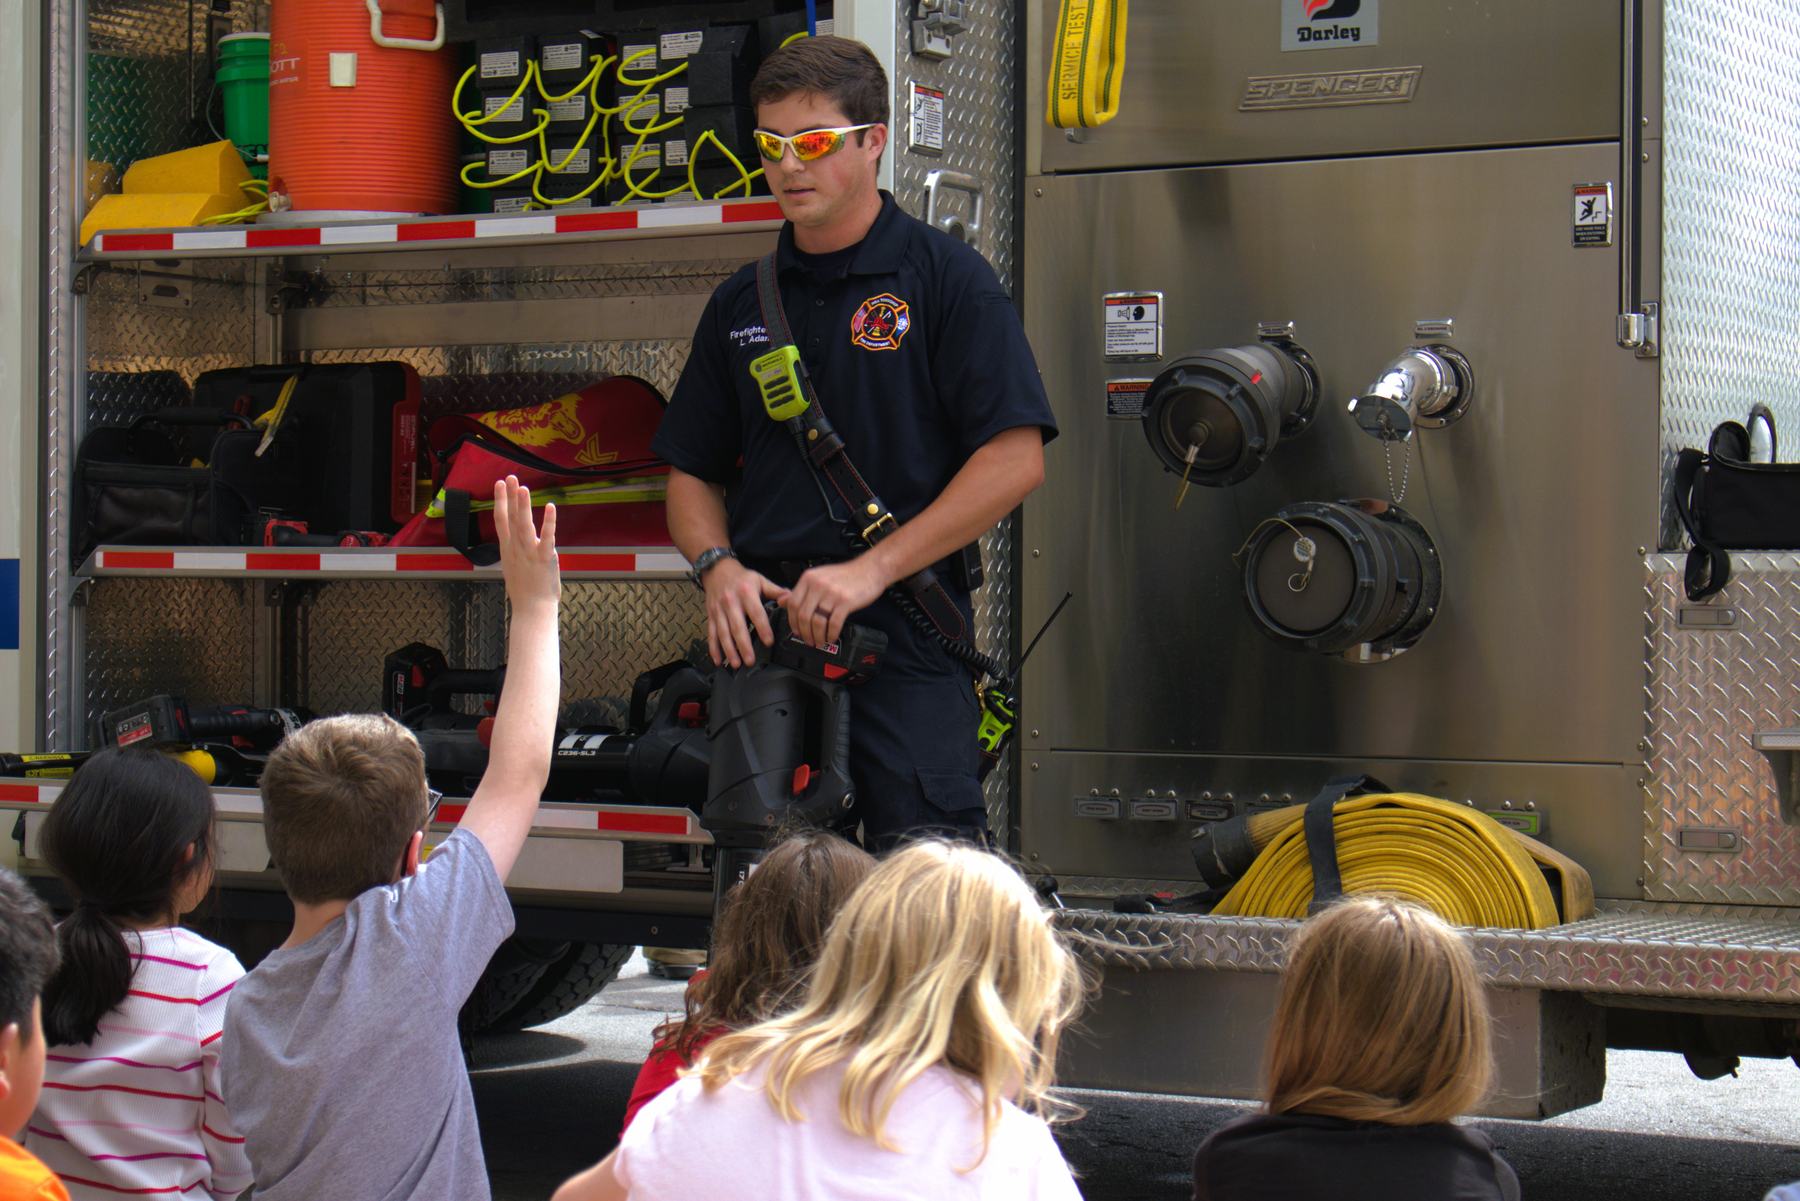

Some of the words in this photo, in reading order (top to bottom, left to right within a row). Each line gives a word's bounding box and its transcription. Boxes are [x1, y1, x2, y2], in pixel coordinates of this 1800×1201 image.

[1067, 5, 1086, 37] TEST
[1297, 25, 1361, 42] Darley
[1061, 41, 1081, 100] SERVICE
[1246, 74, 1399, 97] SPENCER
[730, 325, 768, 340] Firefighte
